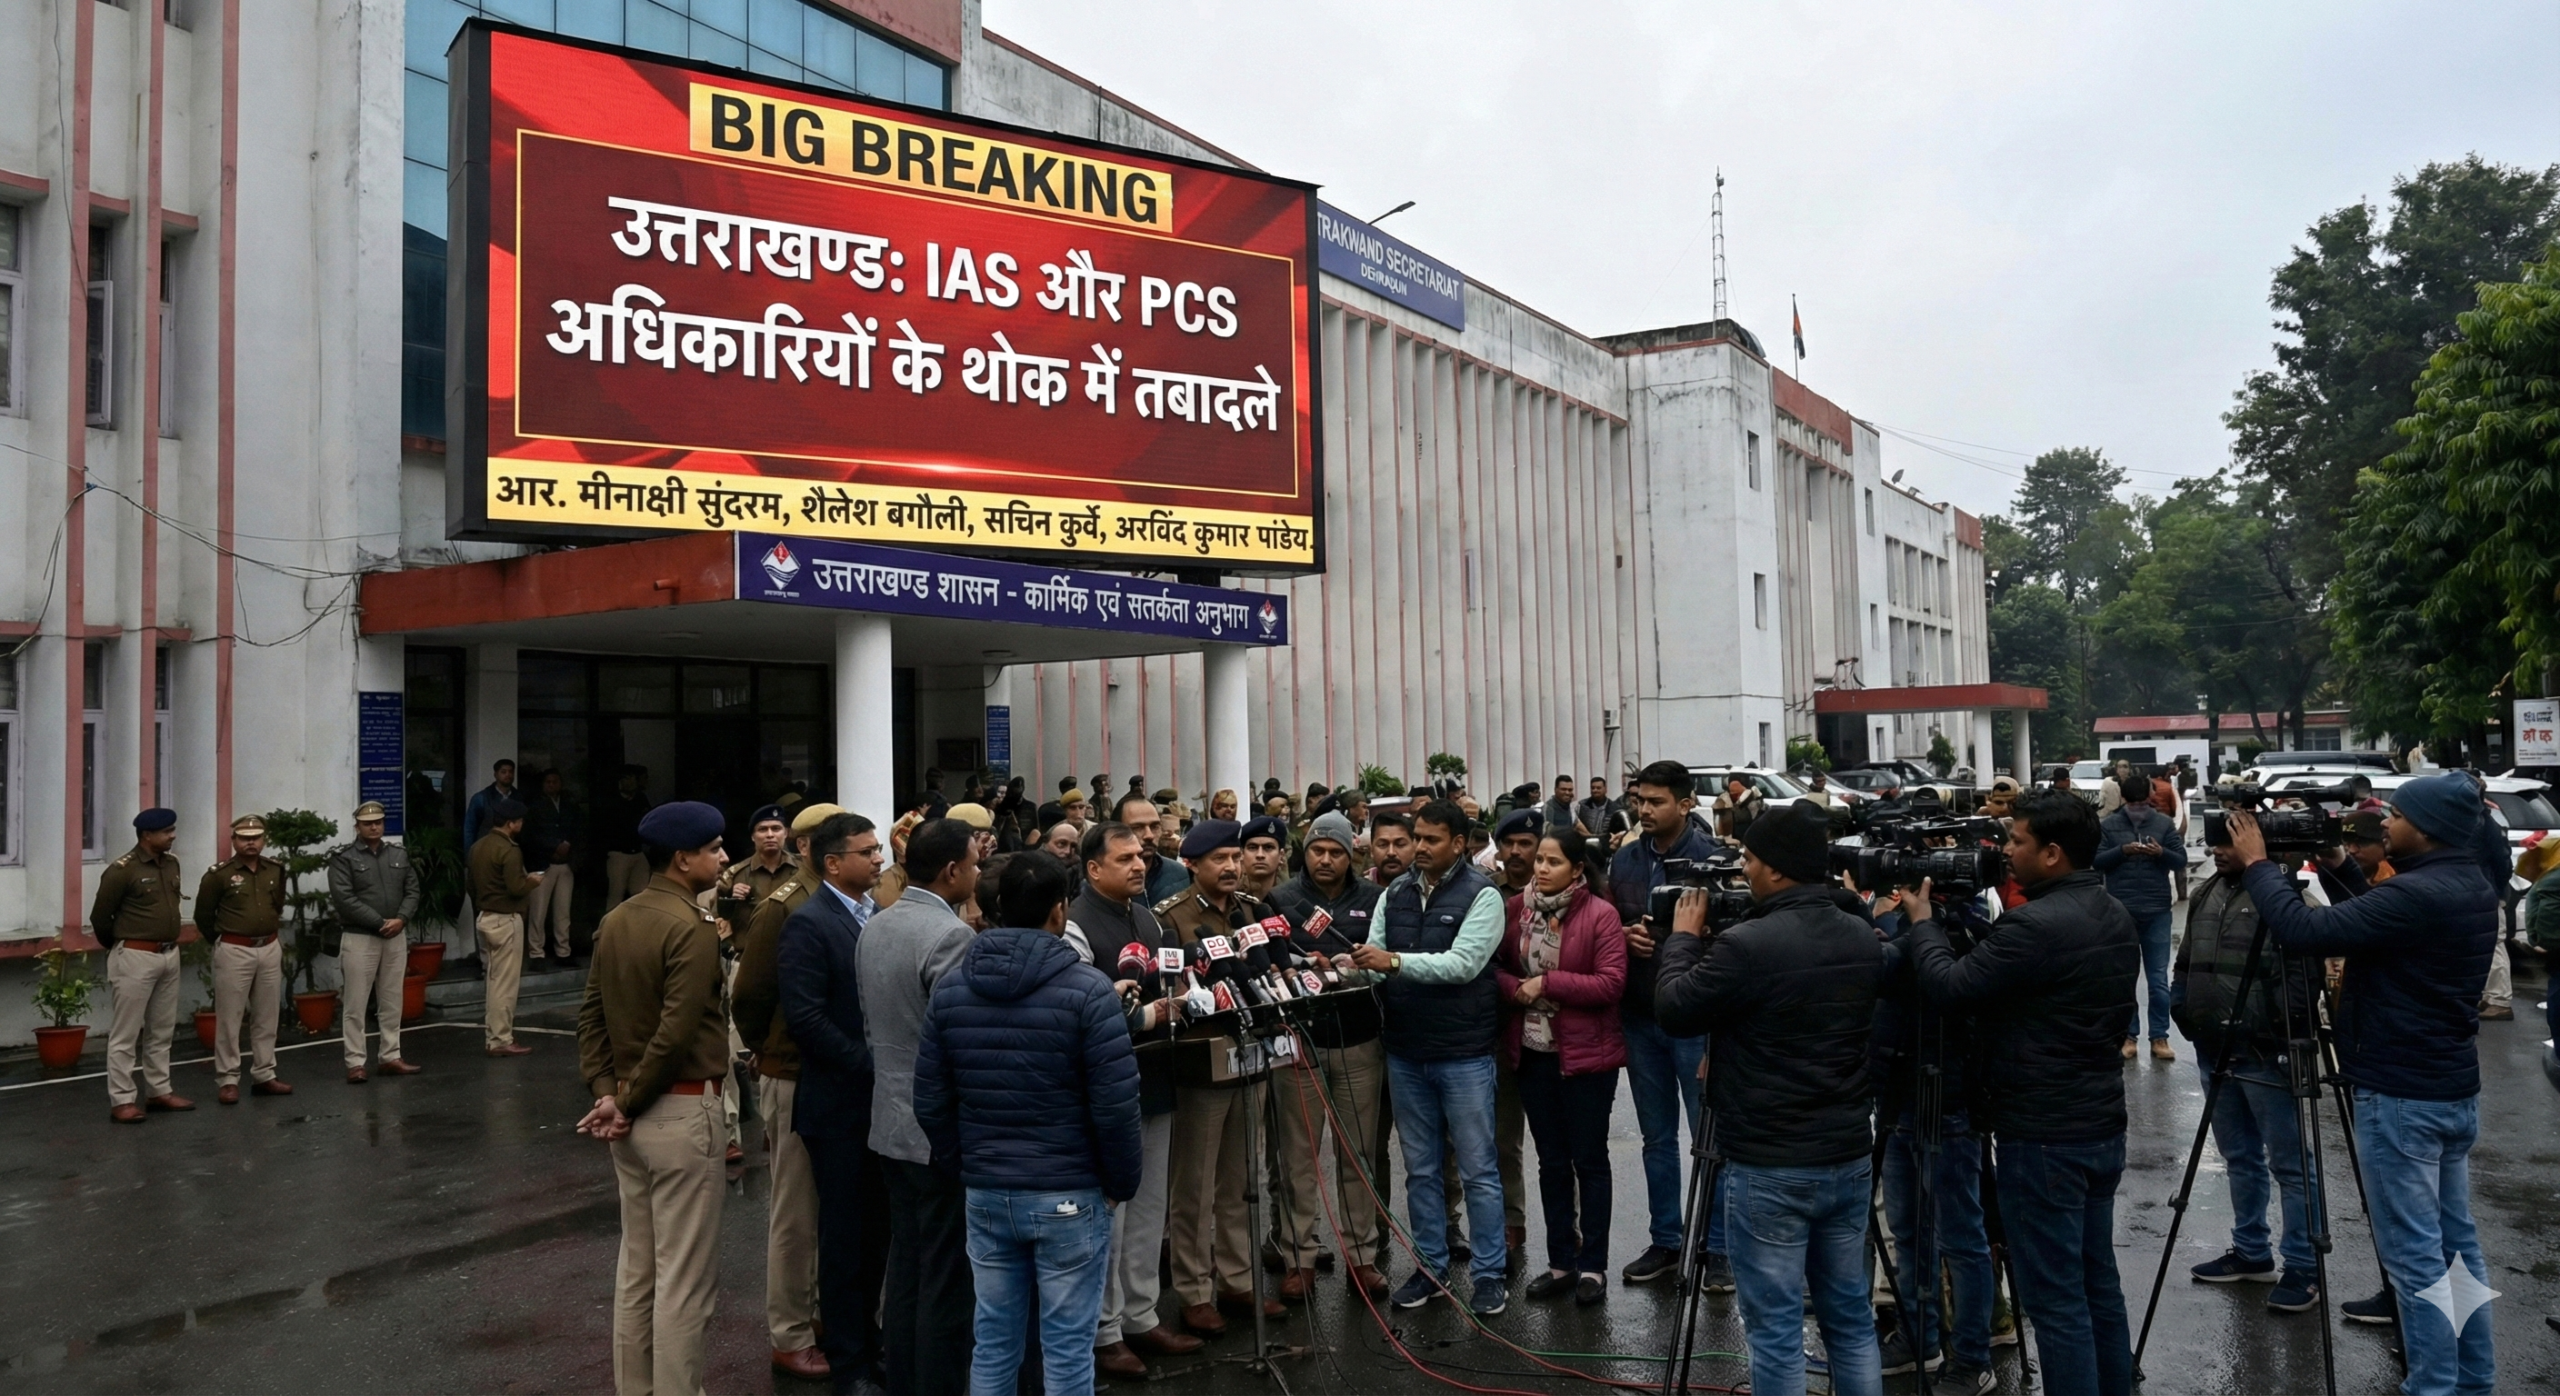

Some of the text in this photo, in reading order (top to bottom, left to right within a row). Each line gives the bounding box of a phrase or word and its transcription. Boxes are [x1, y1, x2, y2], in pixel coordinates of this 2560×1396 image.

[711, 93, 1157, 224] BIG BREAKING
[608, 196, 1239, 338] उत्तराखण्ड: IAS और PCS
[1386, 246, 1460, 301] SECRETARIAT
[545, 283, 1282, 431] अधिकारियों के थोक में तबादले
[496, 476, 567, 508] आर.
[577, 471, 688, 517] मीनाक्षी
[695, 481, 791, 528] सुंदरम,
[800, 486, 878, 527] शैलेश
[887, 493, 975, 537] बगौली,
[983, 500, 1051, 536] सचिन
[1059, 504, 1108, 546] कुर्वे,
[1115, 510, 1187, 545] अरविंद
[1193, 521, 1250, 555] कुमार
[812, 558, 930, 600] उत्तराखण्ड
[937, 572, 1000, 606] शासन
[1024, 569, 1088, 616] कार्मिक
[1095, 582, 1123, 622] एवं
[1127, 588, 1190, 625] सतर्कता
[1195, 600, 1250, 636] अनुभाग
